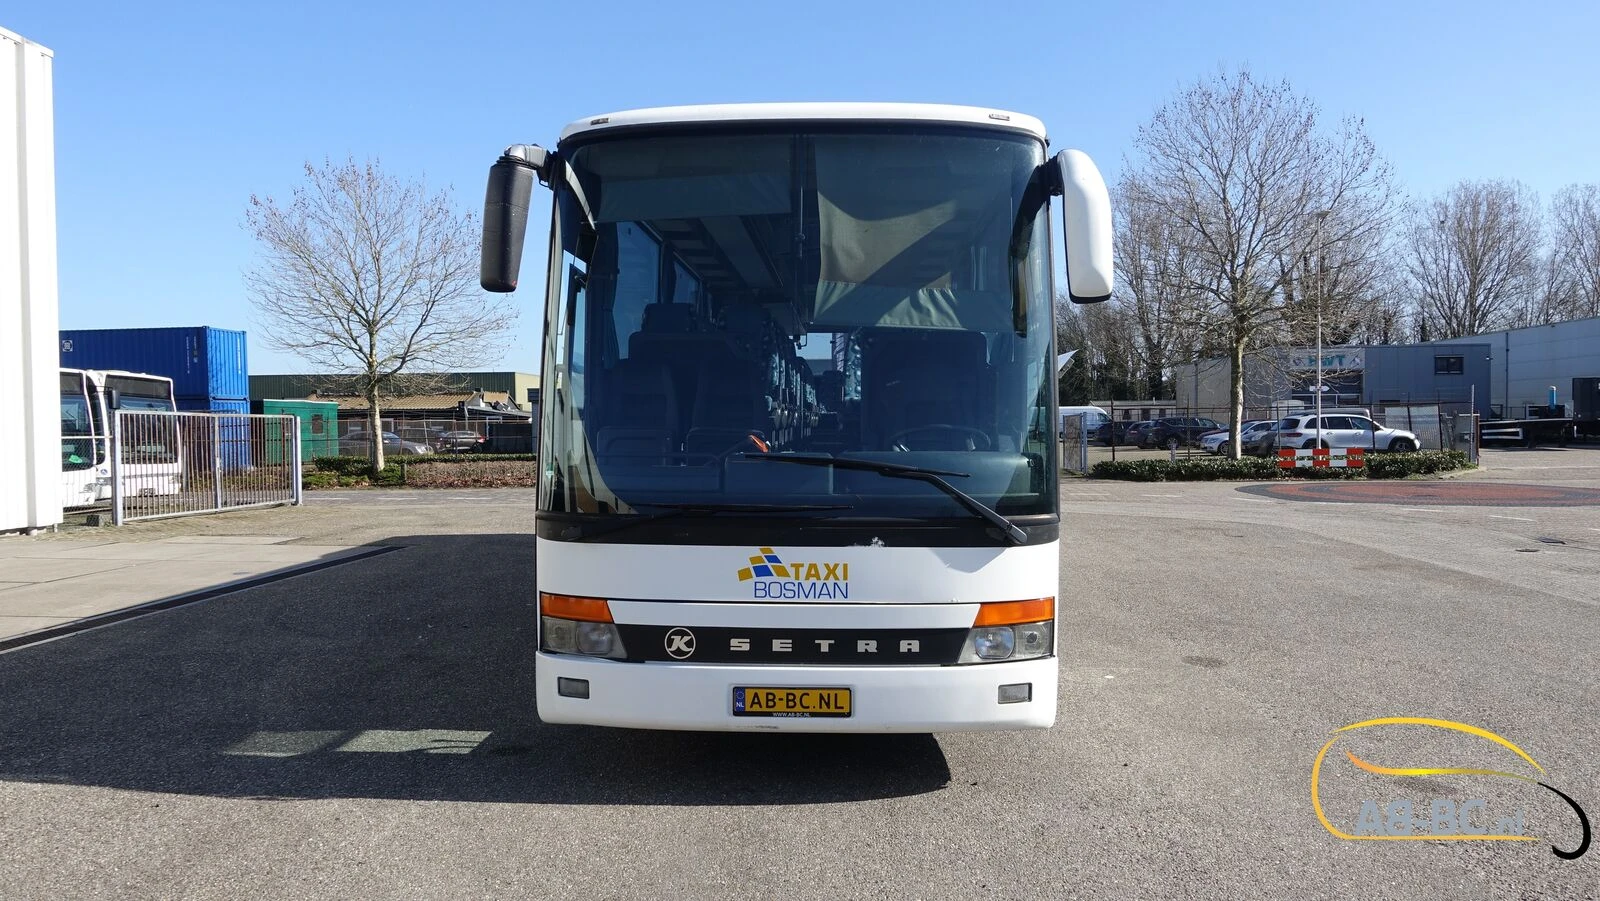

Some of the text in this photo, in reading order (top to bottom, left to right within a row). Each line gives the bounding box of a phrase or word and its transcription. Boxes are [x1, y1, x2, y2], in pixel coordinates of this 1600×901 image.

[790, 563, 848, 581] TAXI
[754, 581, 848, 599] BOSMAN
[668, 635, 693, 652] K
[730, 638, 920, 653] SETRA
[749, 691, 844, 709] AB-BC.NL
